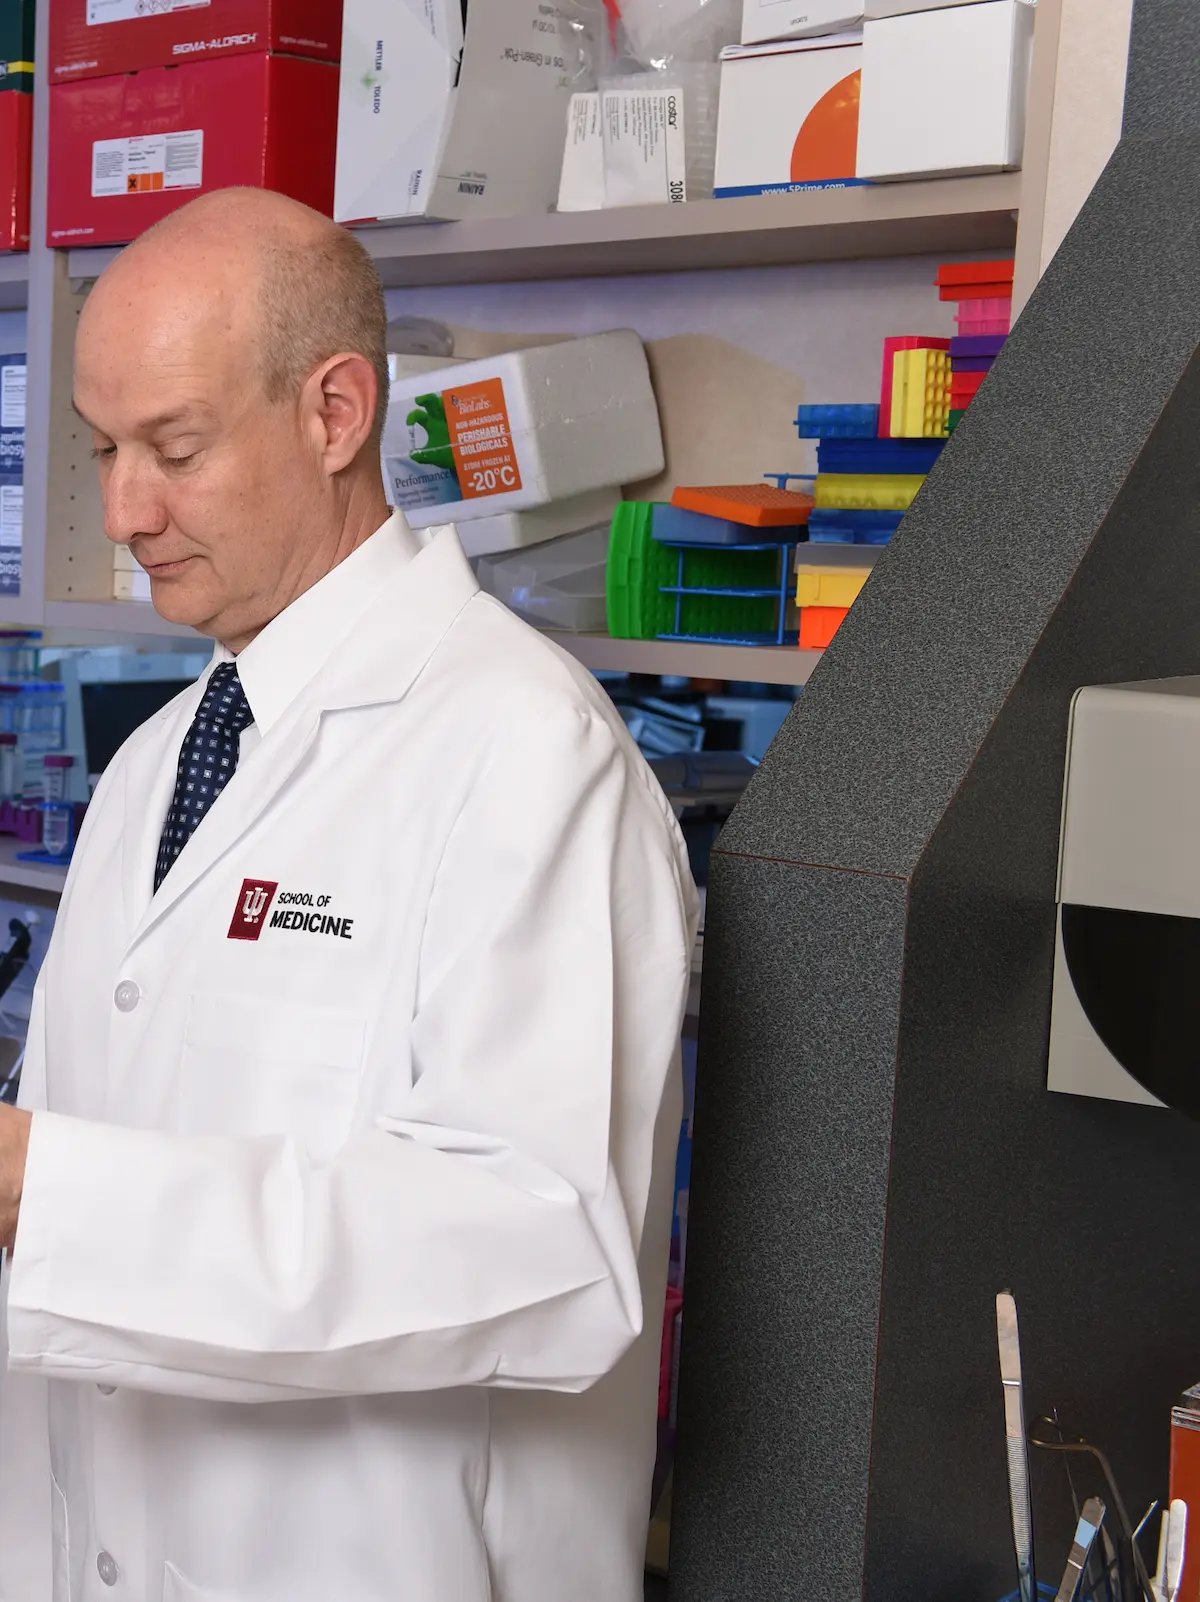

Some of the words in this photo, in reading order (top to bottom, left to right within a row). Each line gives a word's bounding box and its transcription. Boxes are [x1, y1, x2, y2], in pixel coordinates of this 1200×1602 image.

[172, 32, 257, 55] SIGMA-ALDRICH
[375, 40, 384, 71] METTLER
[373, 85, 382, 114] TOLEDO
[668, 95, 677, 127] costar
[458, 182, 486, 196] RAININ
[670, 180, 684, 203] 308
[455, 412, 504, 430] NON-HAZARDOUS
[457, 423, 506, 443] PERISHABLE
[459, 437, 508, 456] BIOLOGICALS
[463, 460, 481, 471] STORE
[482, 457, 502, 468] FROZEN
[503, 454, 511, 464] AT
[467, 465, 516, 492] -20°C
[277, 892, 314, 907] SCHOOL
[316, 894, 332, 907] OF
[269, 910, 354, 940] MEDICINE
